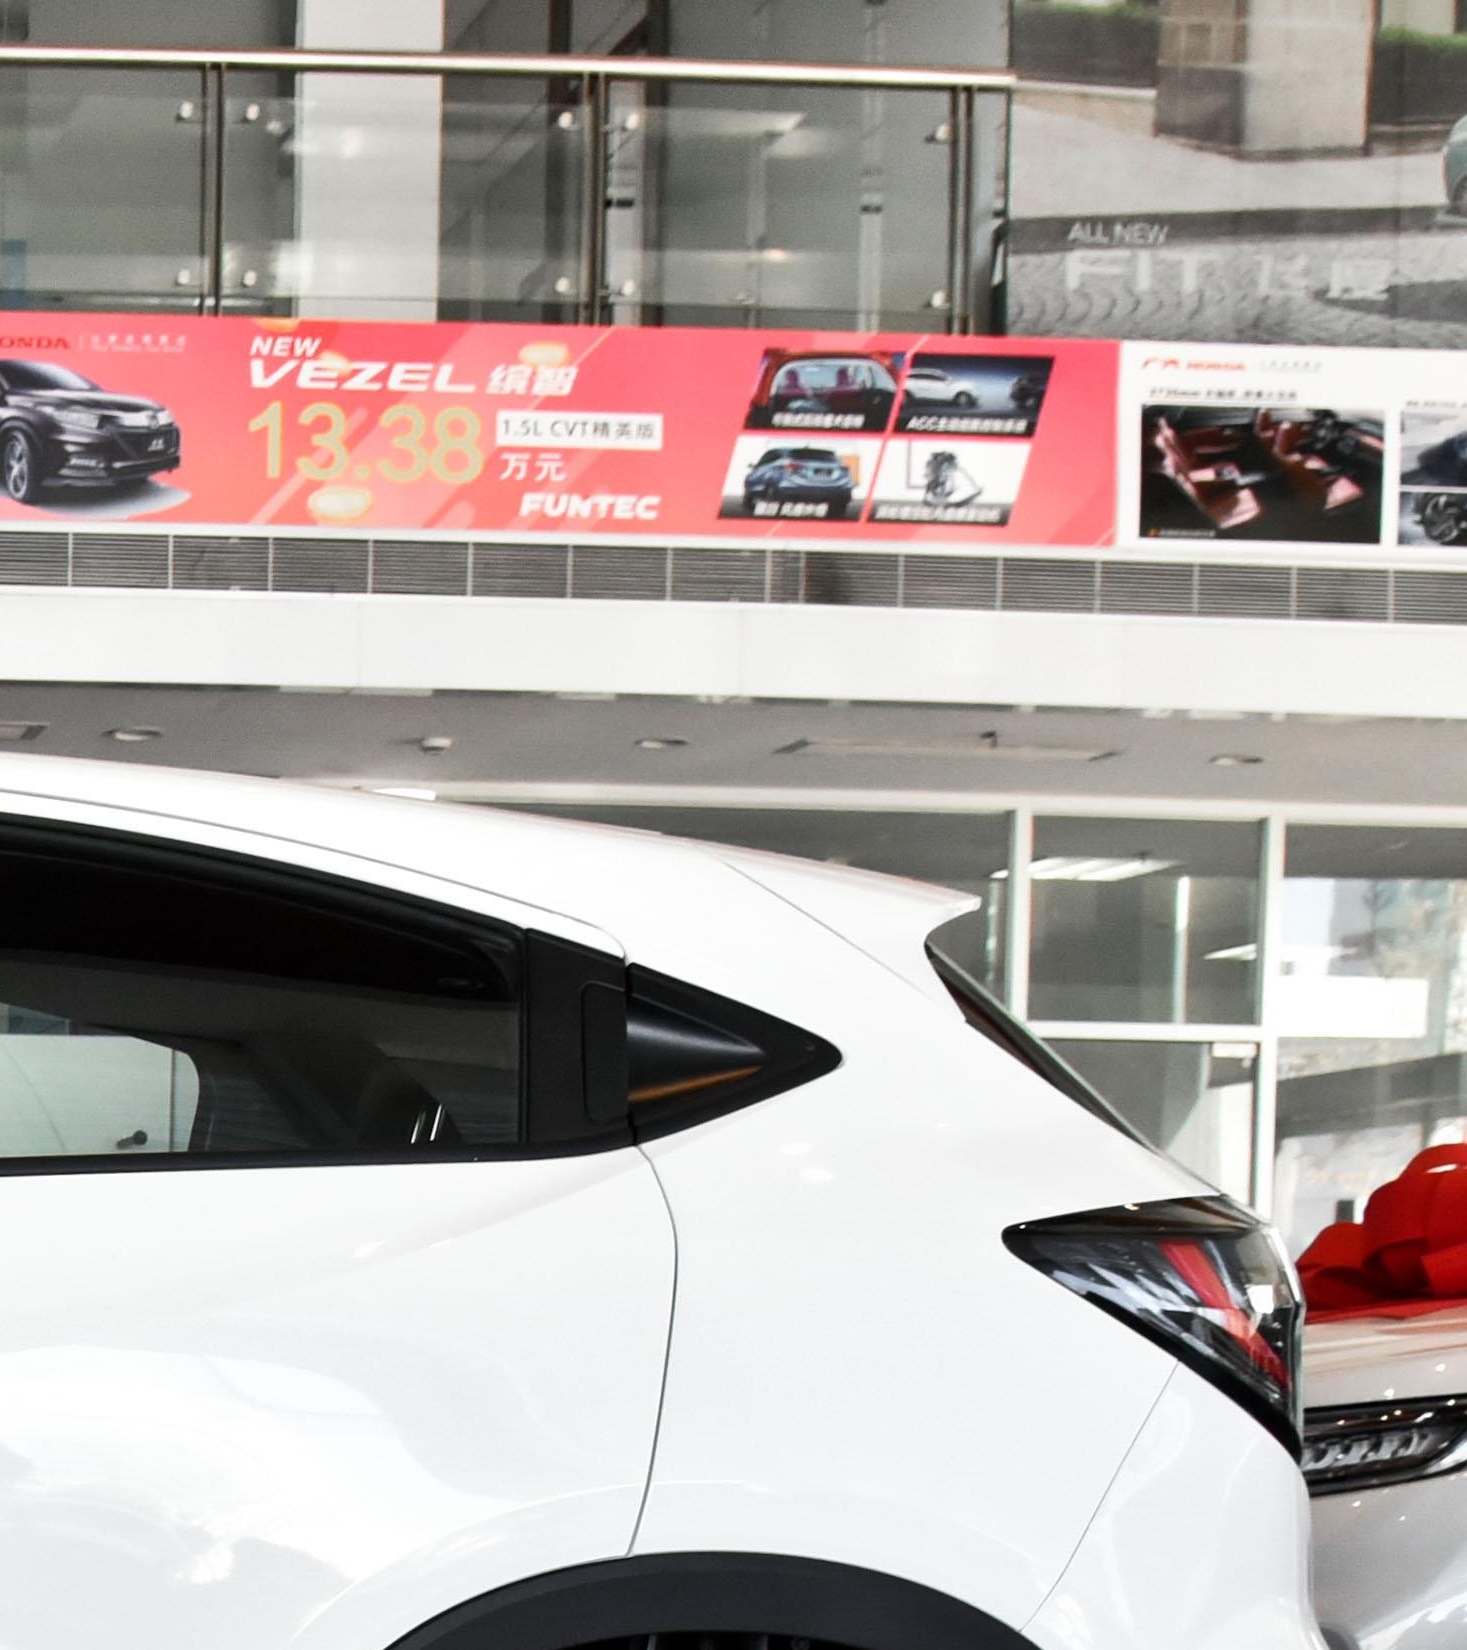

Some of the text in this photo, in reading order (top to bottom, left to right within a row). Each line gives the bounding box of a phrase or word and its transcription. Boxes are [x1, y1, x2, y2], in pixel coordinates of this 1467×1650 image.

[1069, 222, 1169, 245] ALL NEW
[250, 336, 321, 358] NEW
[247, 361, 477, 396] VEZEL
[247, 402, 483, 484] 13.38
[500, 453, 567, 481] 万元
[520, 492, 662, 520] FUNTEC
